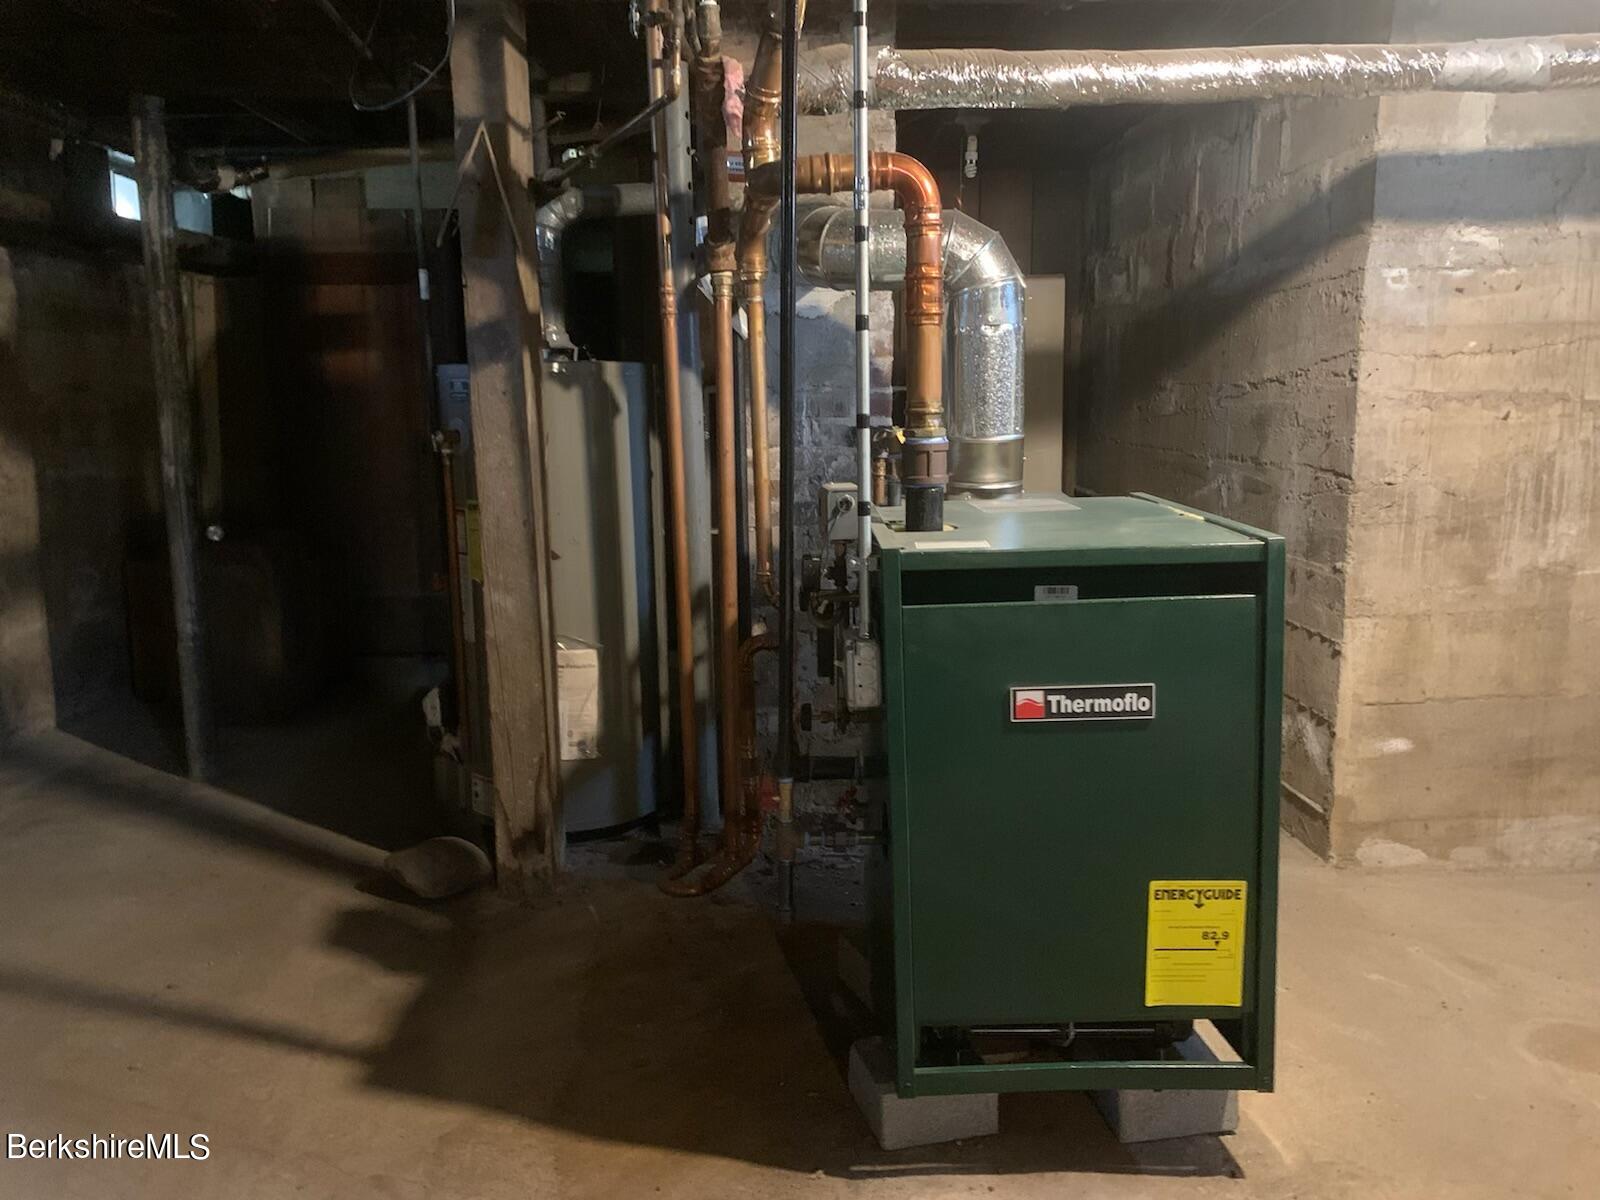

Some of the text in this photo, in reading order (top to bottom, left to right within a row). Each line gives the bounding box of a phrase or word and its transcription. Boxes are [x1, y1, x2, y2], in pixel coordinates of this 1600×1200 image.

[1047, 693, 1151, 714] Thermoflo
[1154, 889, 1242, 901] ENERGYGUIDE
[1202, 931, 1229, 940] 82.9
